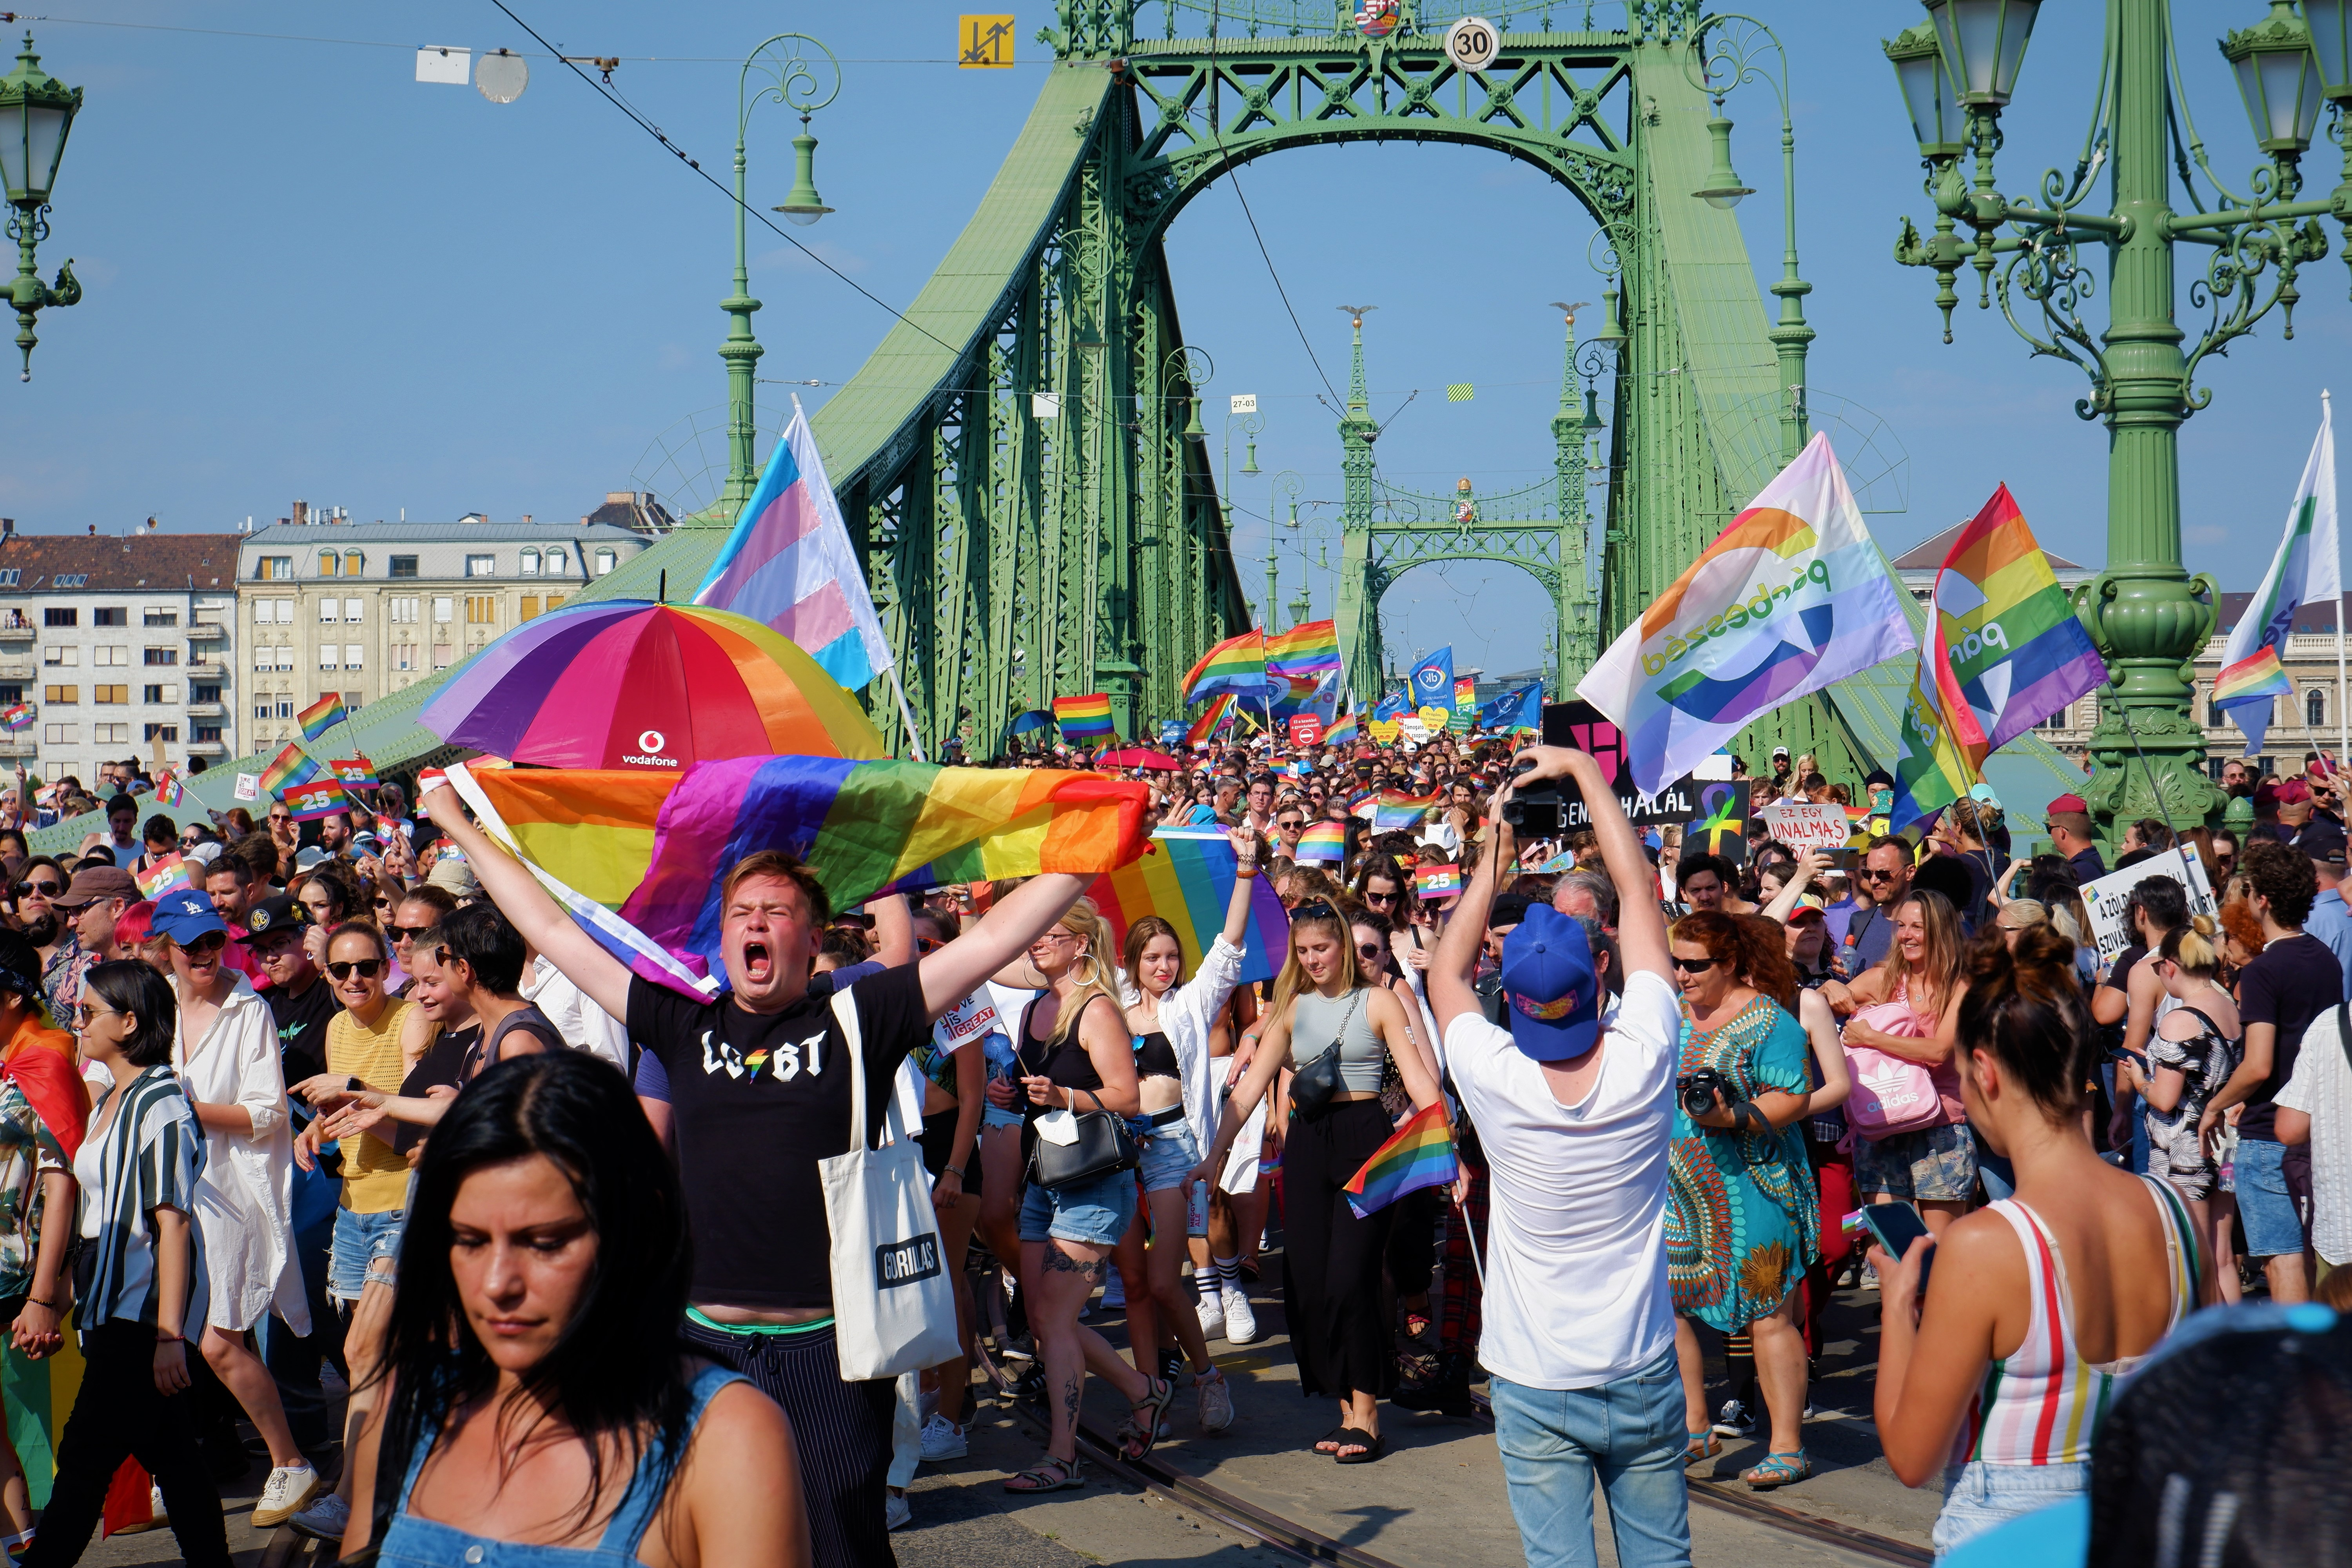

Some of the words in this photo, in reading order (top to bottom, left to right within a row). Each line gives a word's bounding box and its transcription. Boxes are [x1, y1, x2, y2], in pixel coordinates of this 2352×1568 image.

[1457, 31, 1488, 55] 30
[10, 710, 24, 724] 25
[622, 755, 677, 766] vodafone
[342, 767, 366, 781] 25
[165, 780, 178, 799] 25
[1472, 778, 1485, 786] 25
[41, 789, 53, 799] 25
[299, 790, 331, 811] 25
[1350, 788, 1363, 802] 25
[1780, 809, 1796, 818] EZ
[1801, 808, 1822, 818] EGY
[1771, 819, 1845, 840] UNALMAS
[151, 866, 174, 894] 25
[1426, 873, 1450, 889] 25
[182, 901, 203, 915] LA
[2099, 902, 2108, 921] A
[950, 1015, 962, 1026] IS
[956, 1007, 994, 1035] GREAT
[971, 1024, 986, 1036] BRITAIN
[1867, 1092, 1919, 1112] adidas
[884, 1241, 934, 1280] GORILLAS
